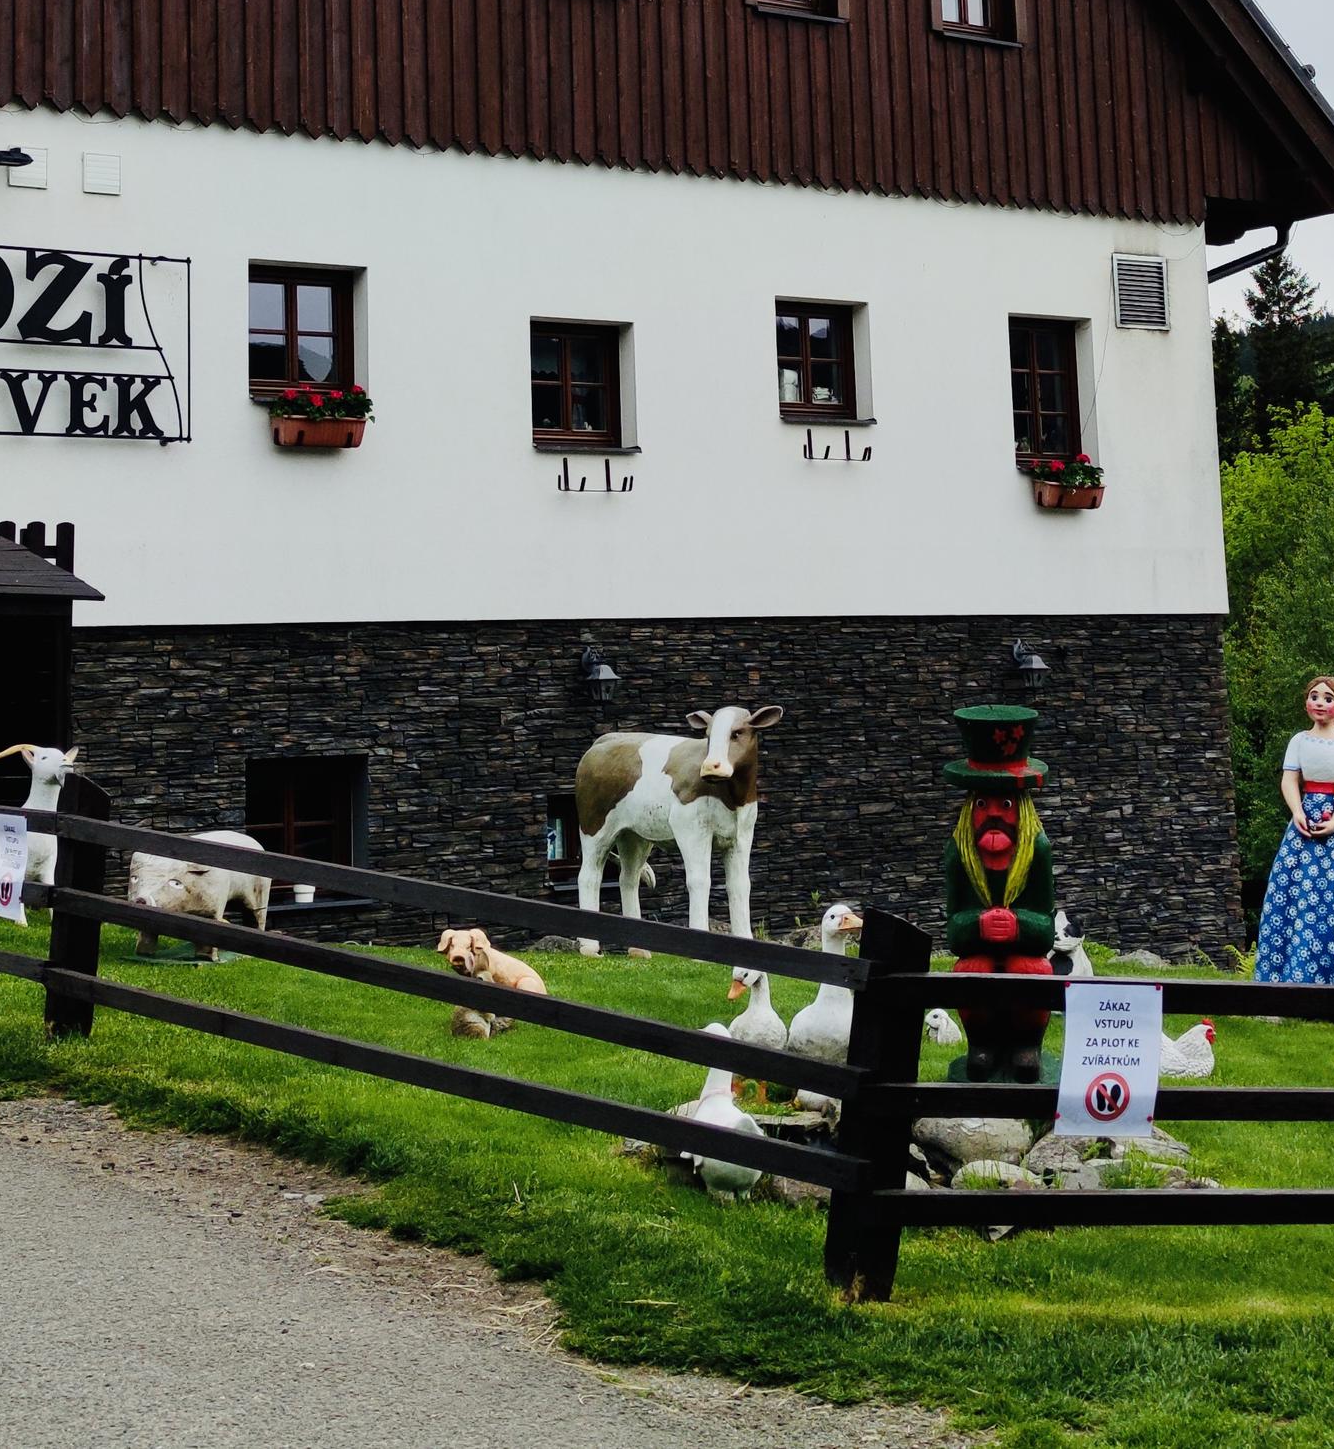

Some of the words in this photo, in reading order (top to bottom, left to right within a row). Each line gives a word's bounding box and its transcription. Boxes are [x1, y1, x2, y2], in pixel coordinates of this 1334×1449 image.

[1099, 999, 1131, 1012] ZÁKAZ
[1094, 1018, 1134, 1029] VSTUPU
[1086, 1037, 1098, 1047] ZA
[1101, 1038, 1125, 1048] PLOT
[1128, 1038, 1140, 1048] KE
[1082, 1053, 1140, 1066] ZVÍŘÁTKŮM
